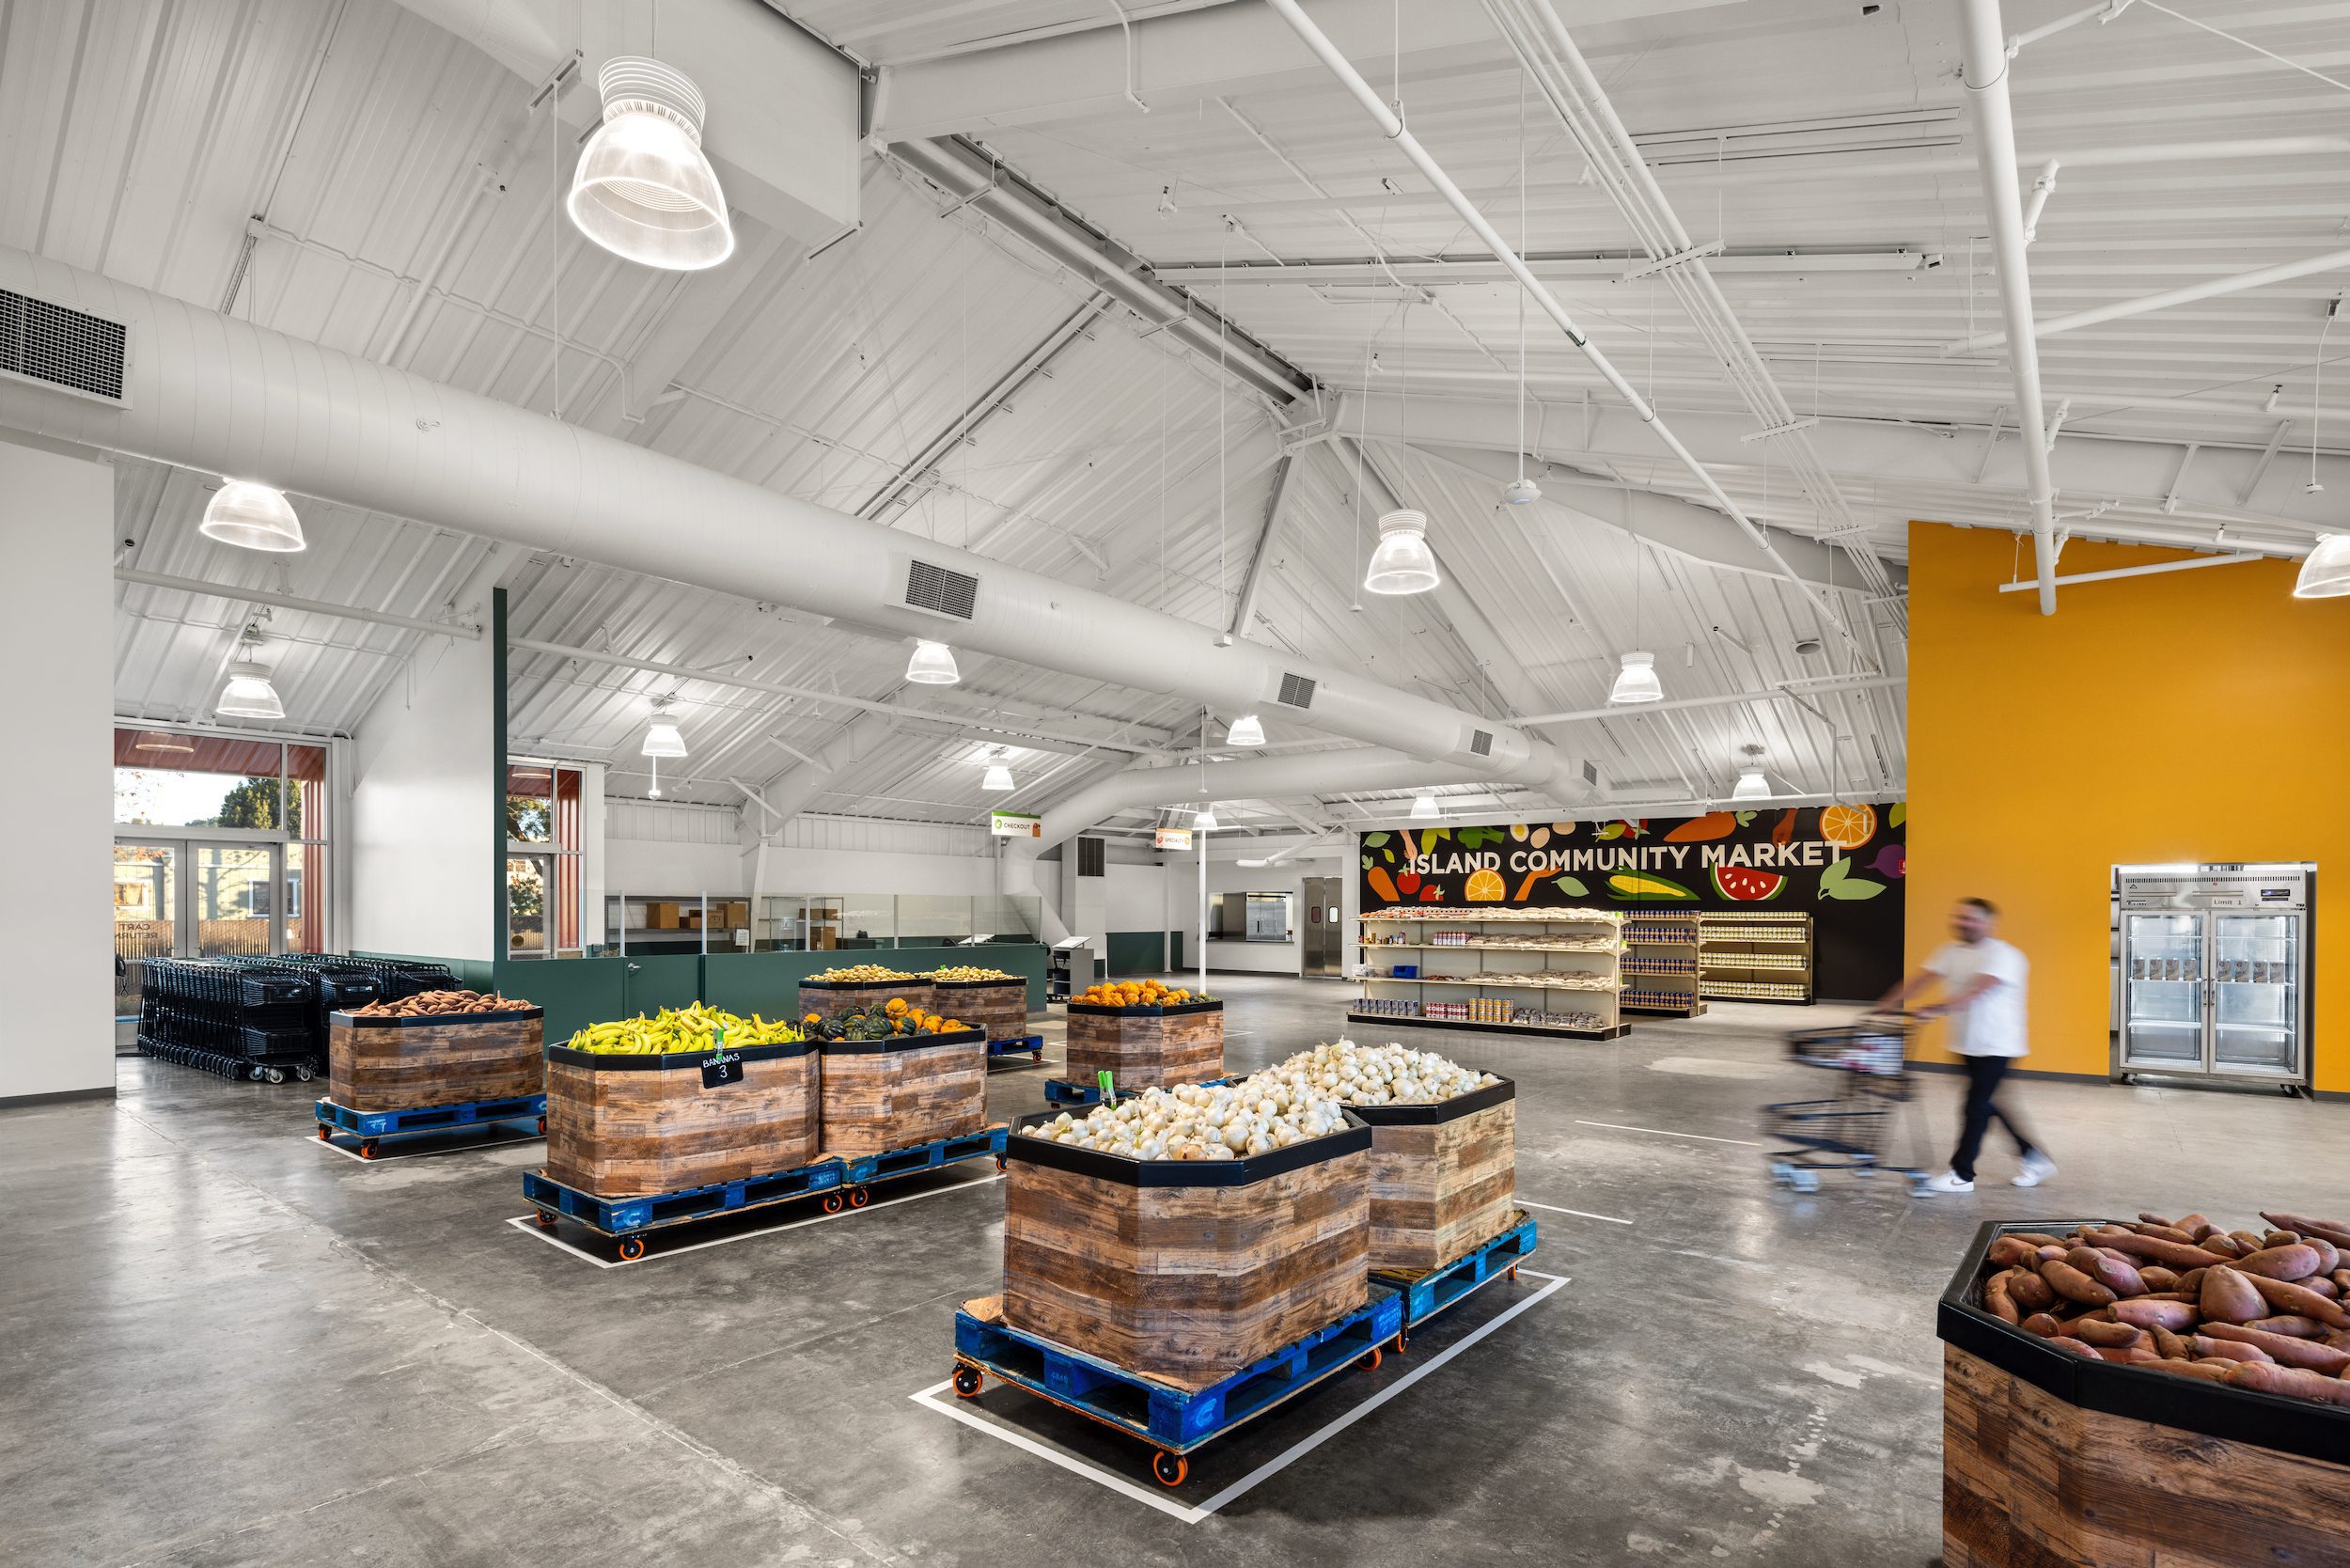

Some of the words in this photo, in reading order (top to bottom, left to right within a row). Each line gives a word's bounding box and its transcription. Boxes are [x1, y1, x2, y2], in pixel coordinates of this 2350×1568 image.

[1409, 852, 1501, 874] ISLAND
[1509, 846, 1691, 872] COMMUNITY
[1701, 840, 1848, 869] MARKET
[718, 1064, 728, 1078] 3
